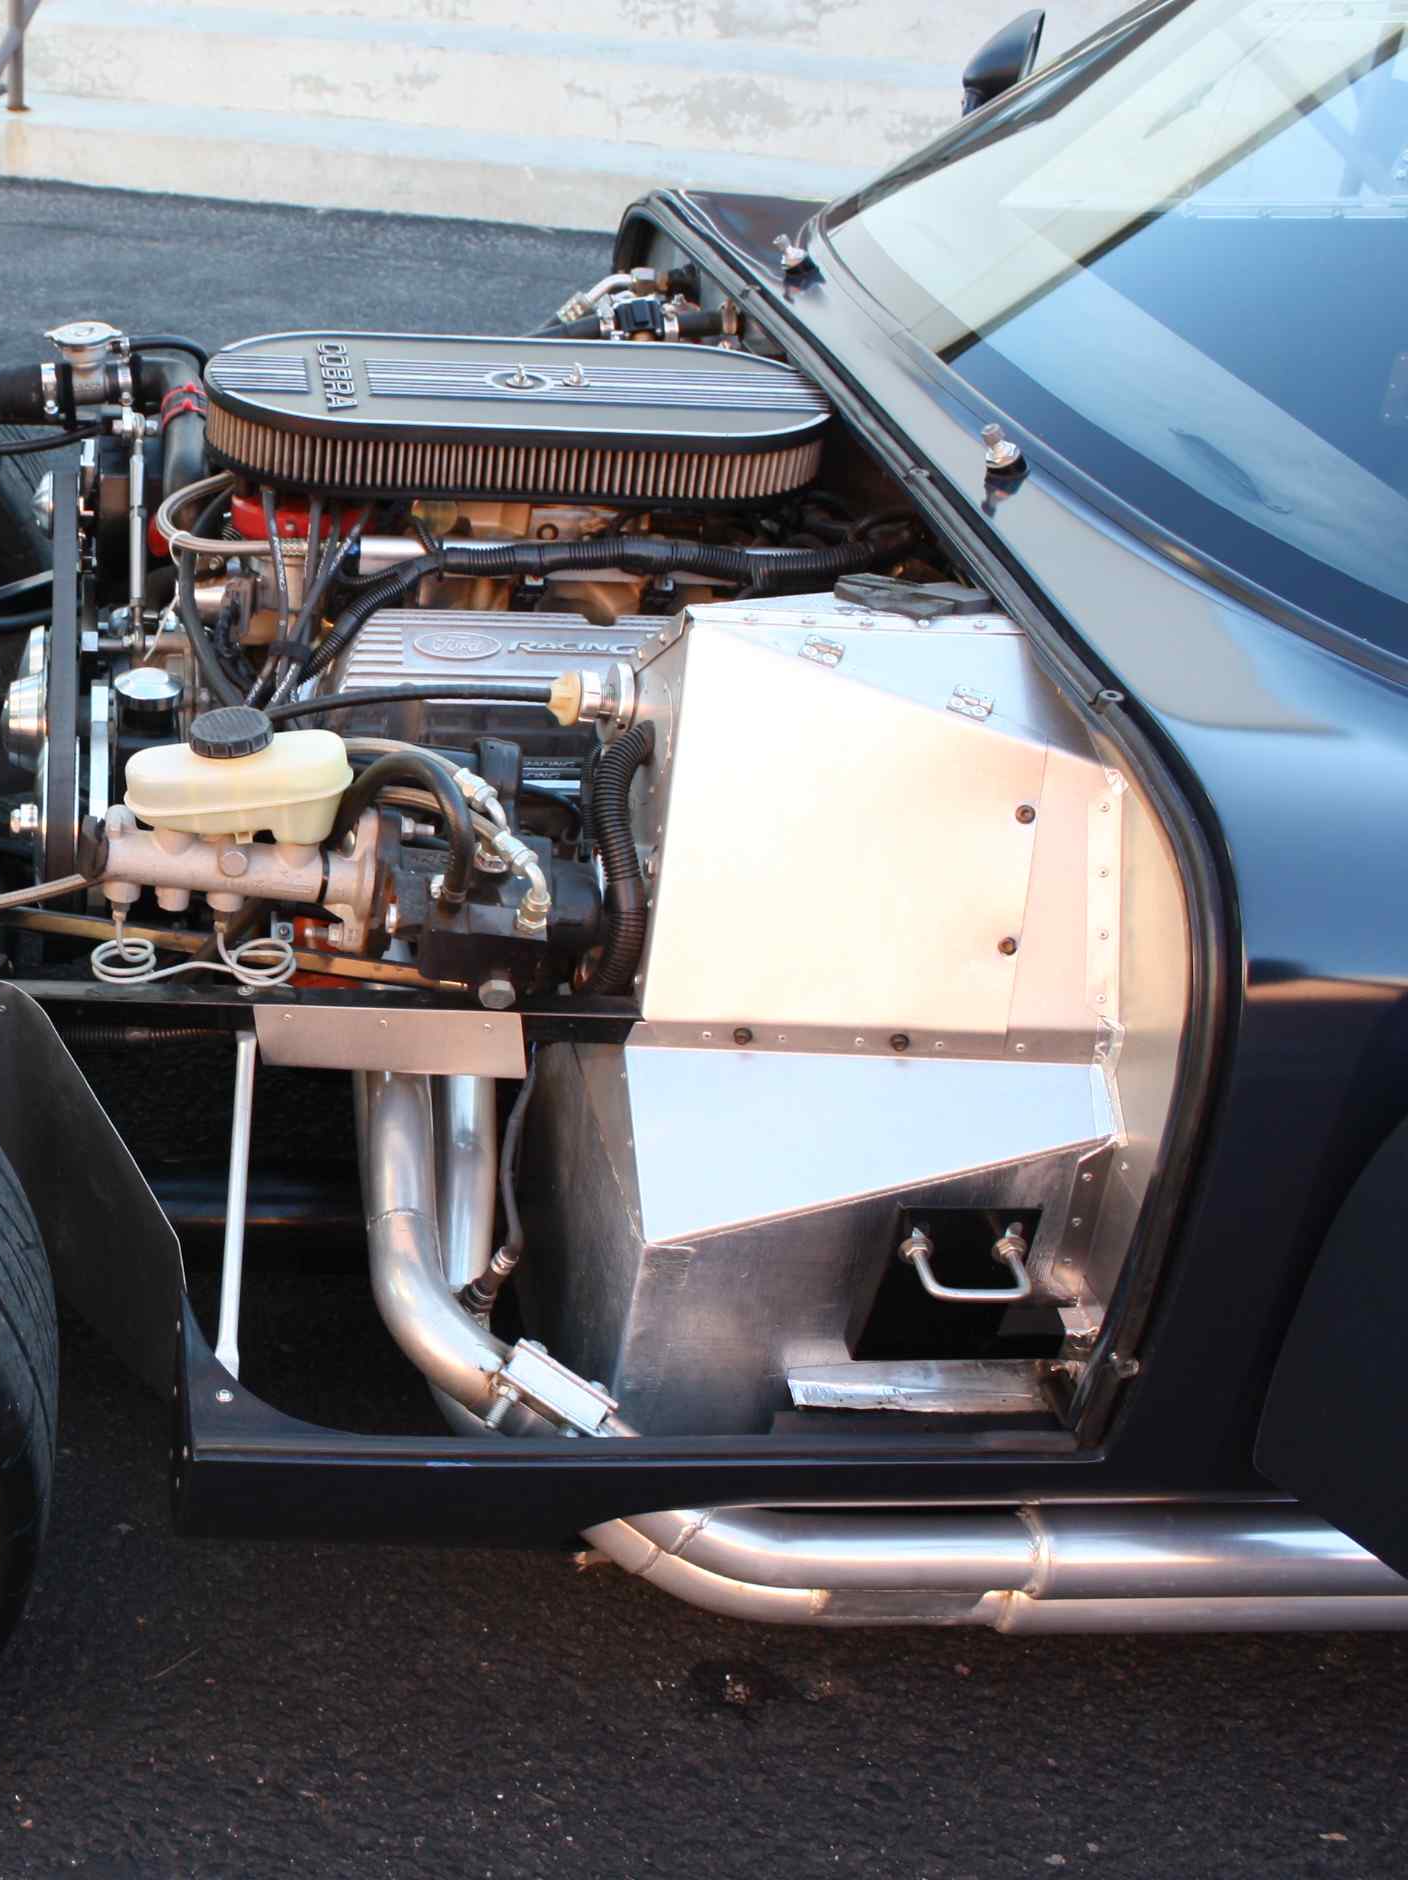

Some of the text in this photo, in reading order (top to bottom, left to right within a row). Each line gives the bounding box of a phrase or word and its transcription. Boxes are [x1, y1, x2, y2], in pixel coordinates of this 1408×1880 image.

[317, 343, 359, 407] COBRA
[432, 639, 639, 656] Ford RACING
